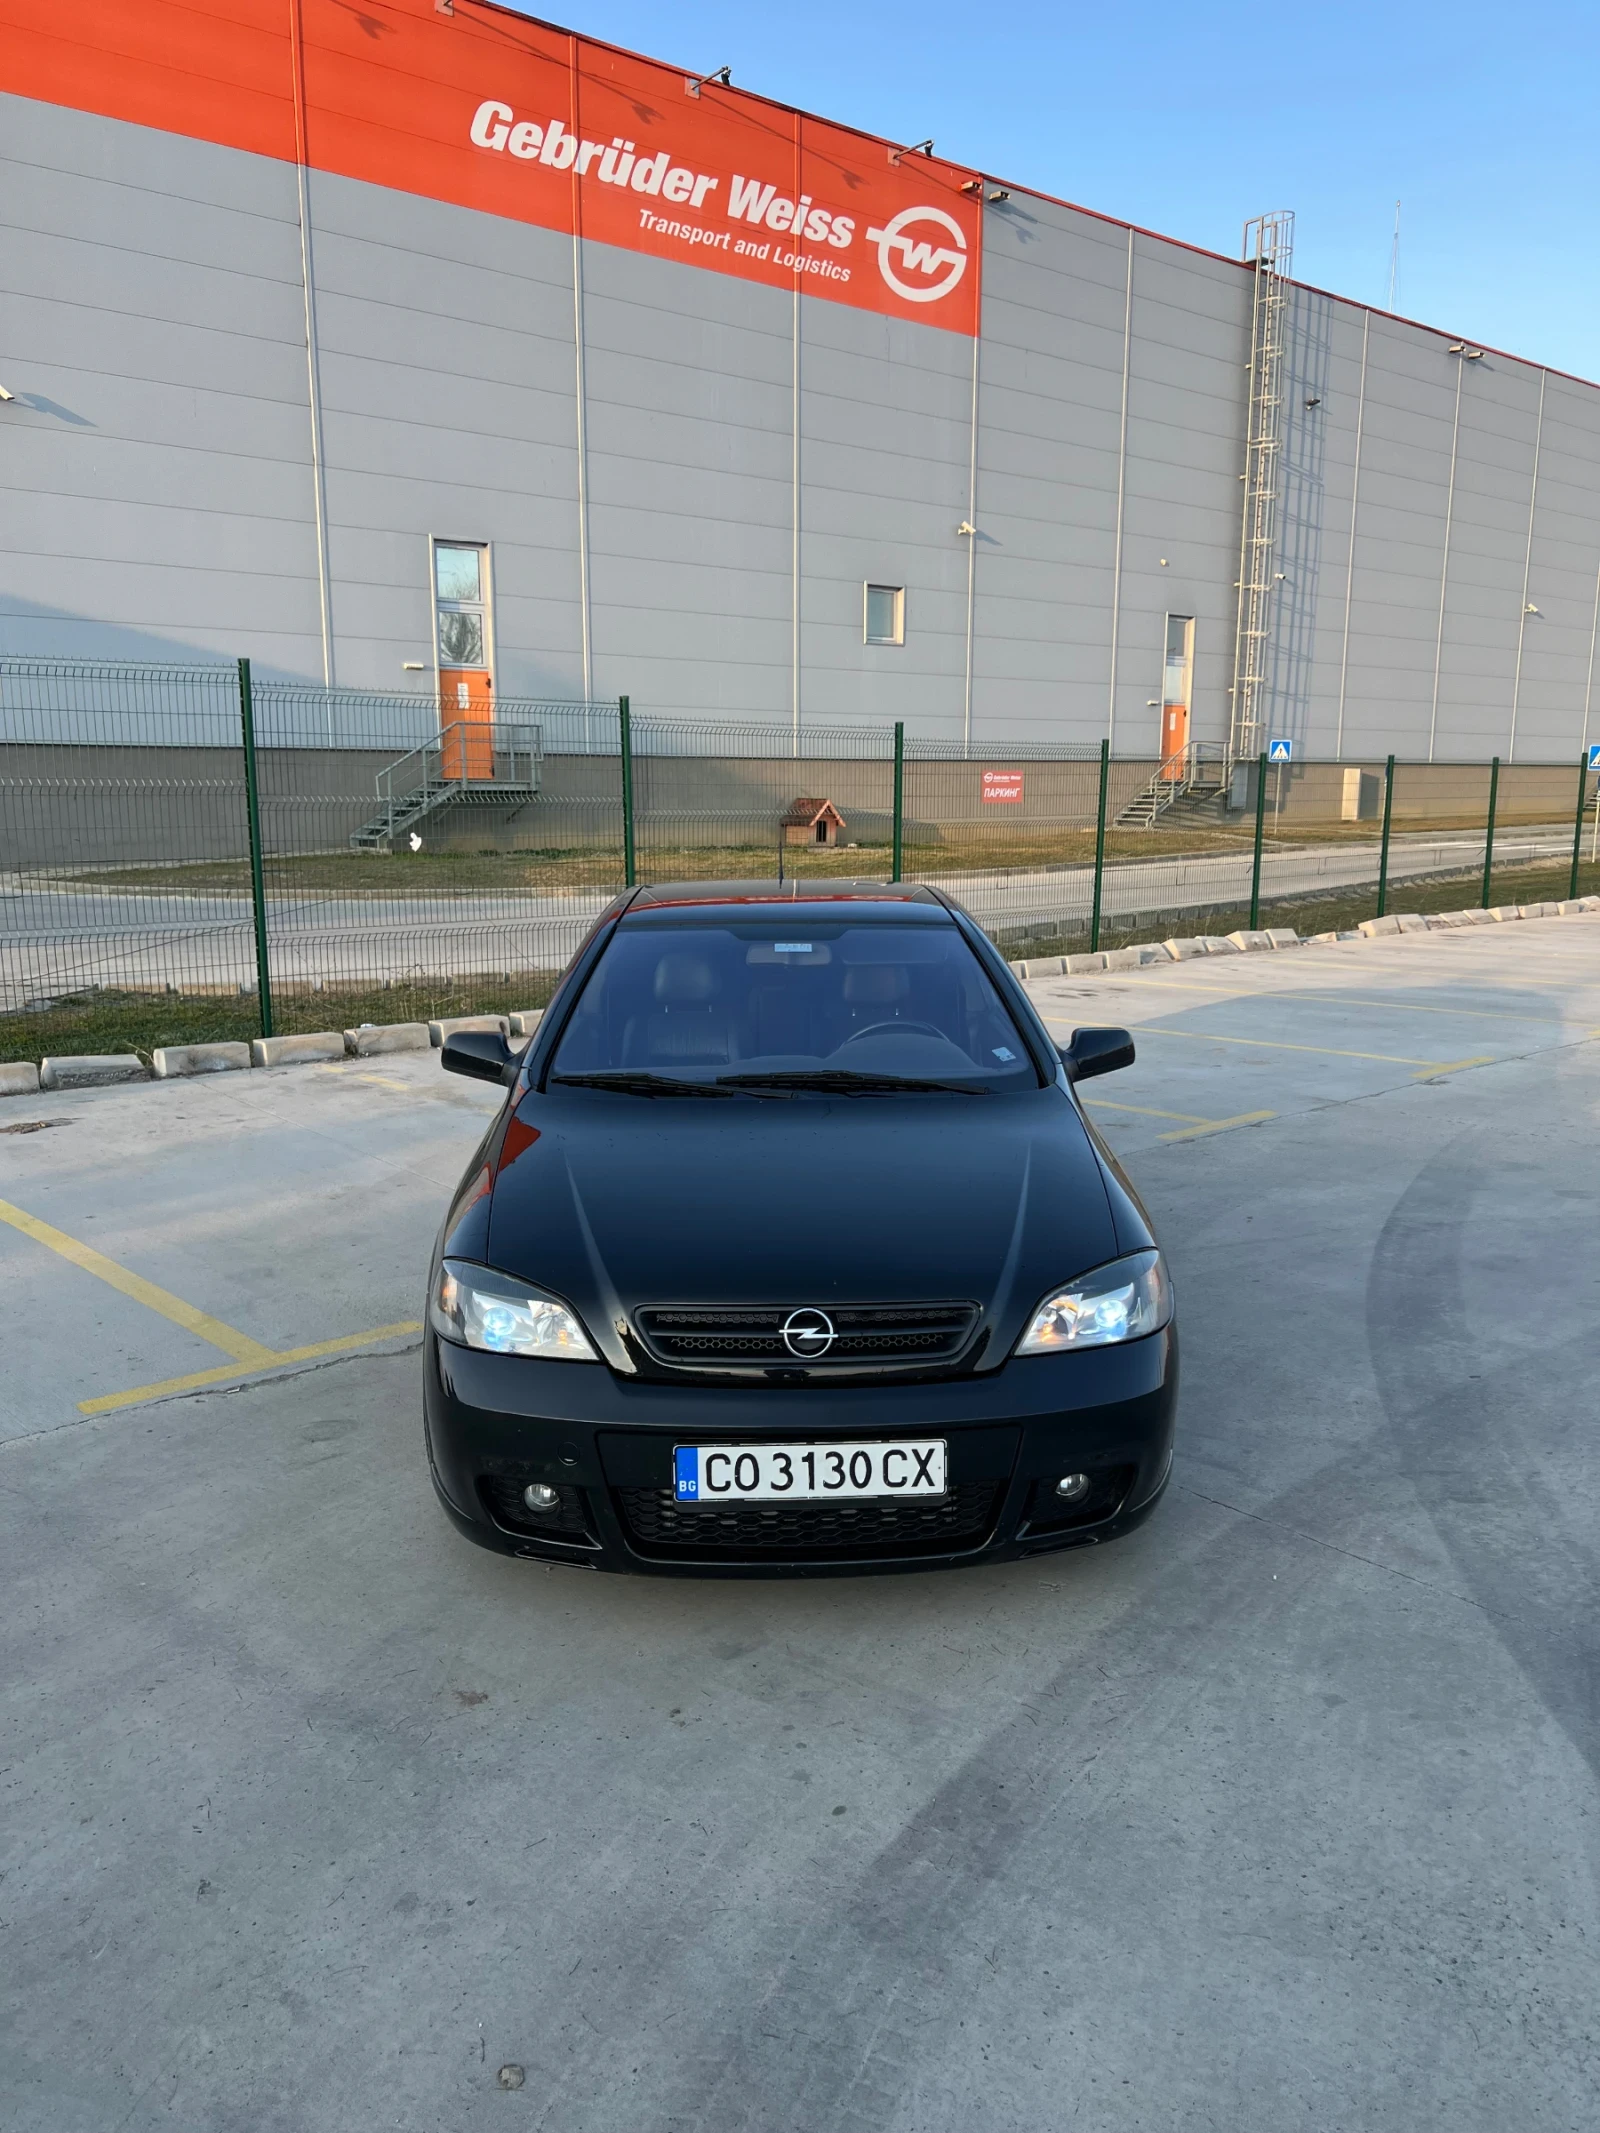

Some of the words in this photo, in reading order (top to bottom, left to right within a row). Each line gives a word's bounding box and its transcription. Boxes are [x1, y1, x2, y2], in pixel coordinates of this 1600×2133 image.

[470, 100, 718, 208] Gebrüder
[727, 174, 855, 249] Weiss
[639, 208, 731, 250] Transport
[734, 239, 770, 260] and
[773, 246, 851, 283] Logistics
[984, 787, 1021, 798] ПАРКИНГ
[679, 1480, 697, 1492] BG
[705, 1452, 760, 1492] CO
[770, 1450, 873, 1491] 3130
[882, 1448, 936, 1488] CX
